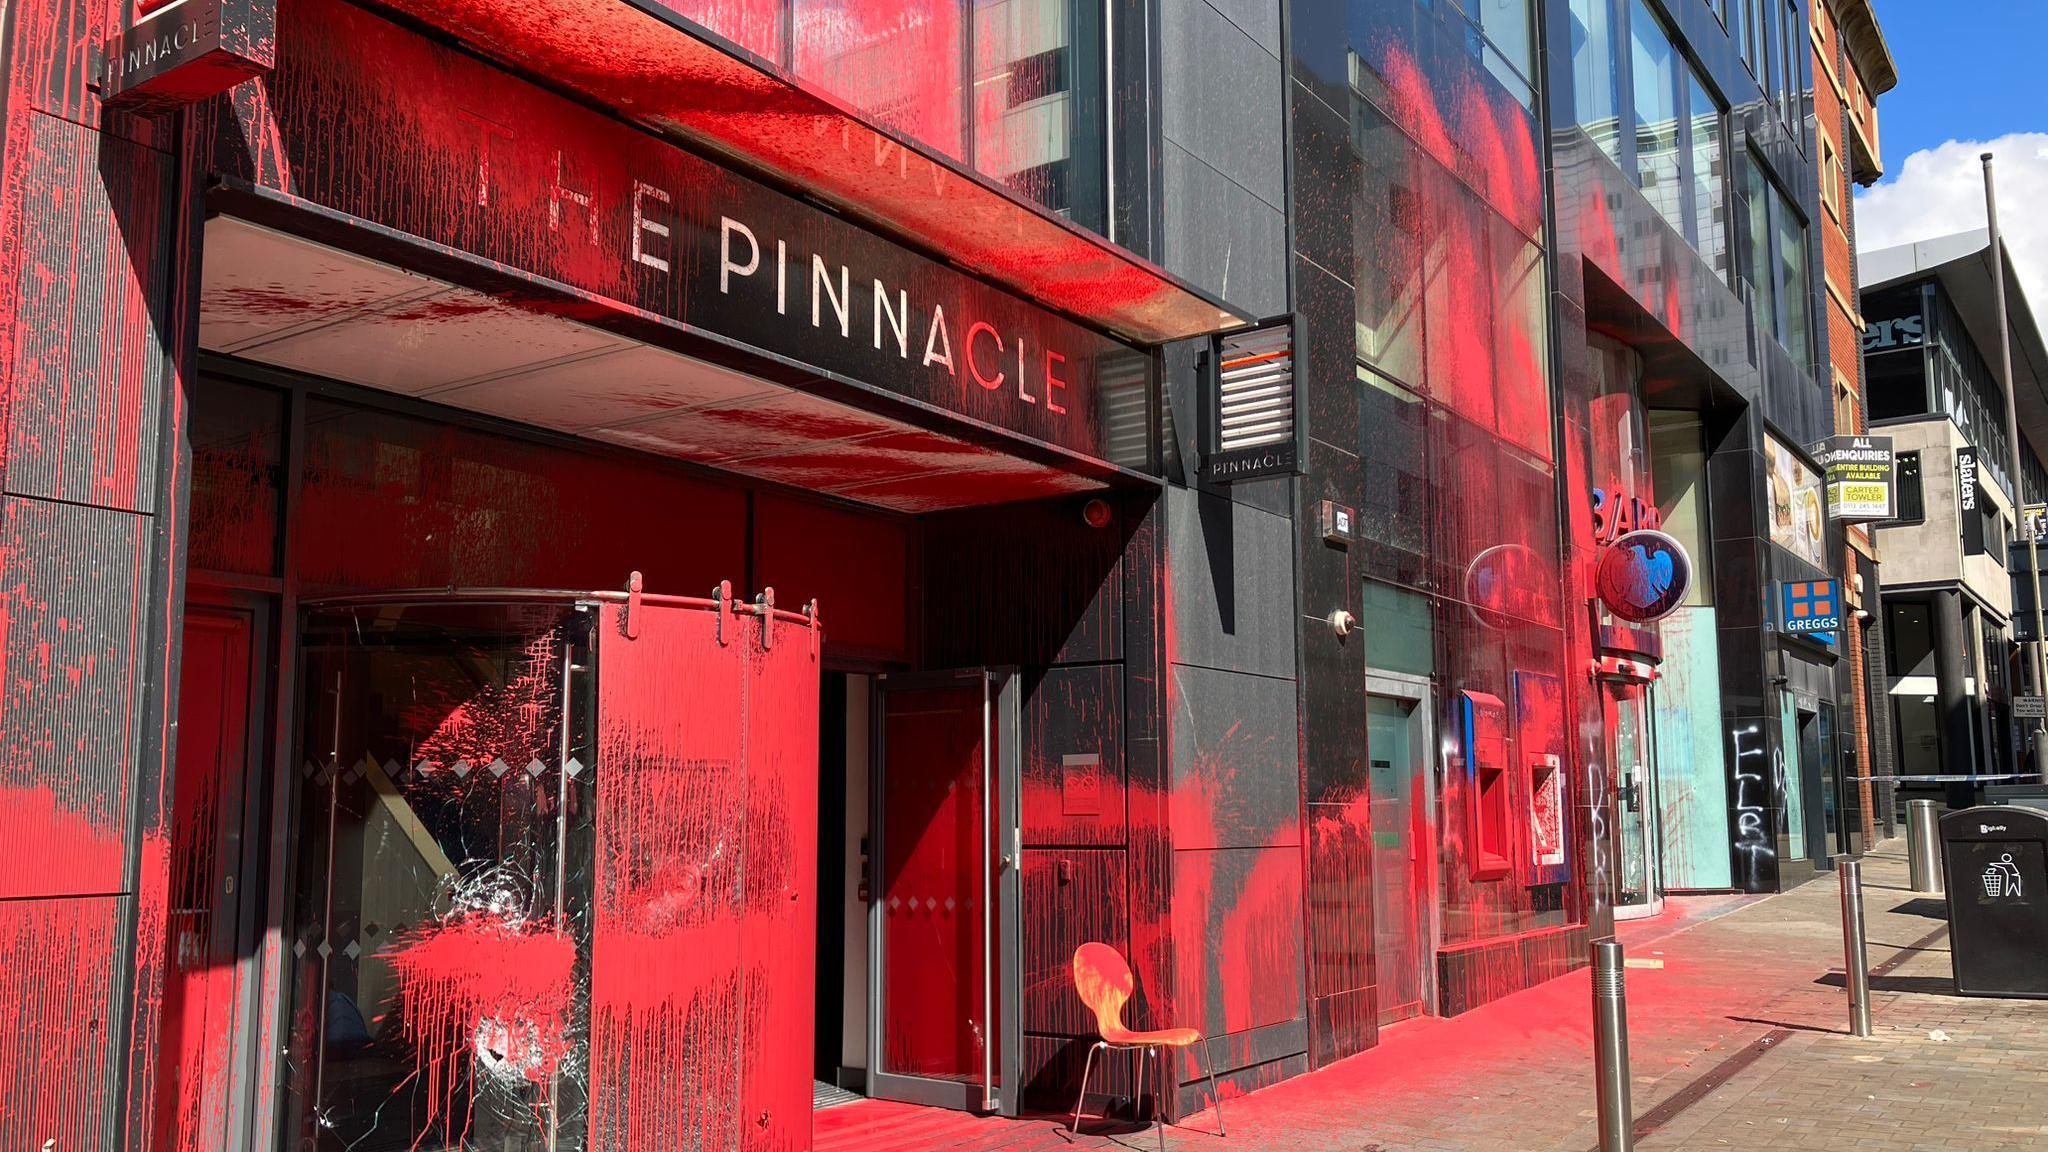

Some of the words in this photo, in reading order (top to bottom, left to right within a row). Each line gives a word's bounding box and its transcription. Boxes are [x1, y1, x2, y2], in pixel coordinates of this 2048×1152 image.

[107, 9, 214, 83] PINNACLE
[457, 108, 671, 273] THE
[719, 214, 1068, 415] PINNACLE
[1852, 437, 1872, 449] ALL
[1835, 449, 1891, 461] ENQUIRIES
[1212, 449, 1295, 476] PINNACLE
[1837, 463, 1859, 471] ENTIRE
[1859, 463, 1890, 472] BUILDING
[1845, 472, 1881, 480] AVAILABLE
[1958, 454, 1977, 511] slaters
[1847, 493, 1882, 501] TOWLER
[1787, 617, 1839, 631] GREGGS
